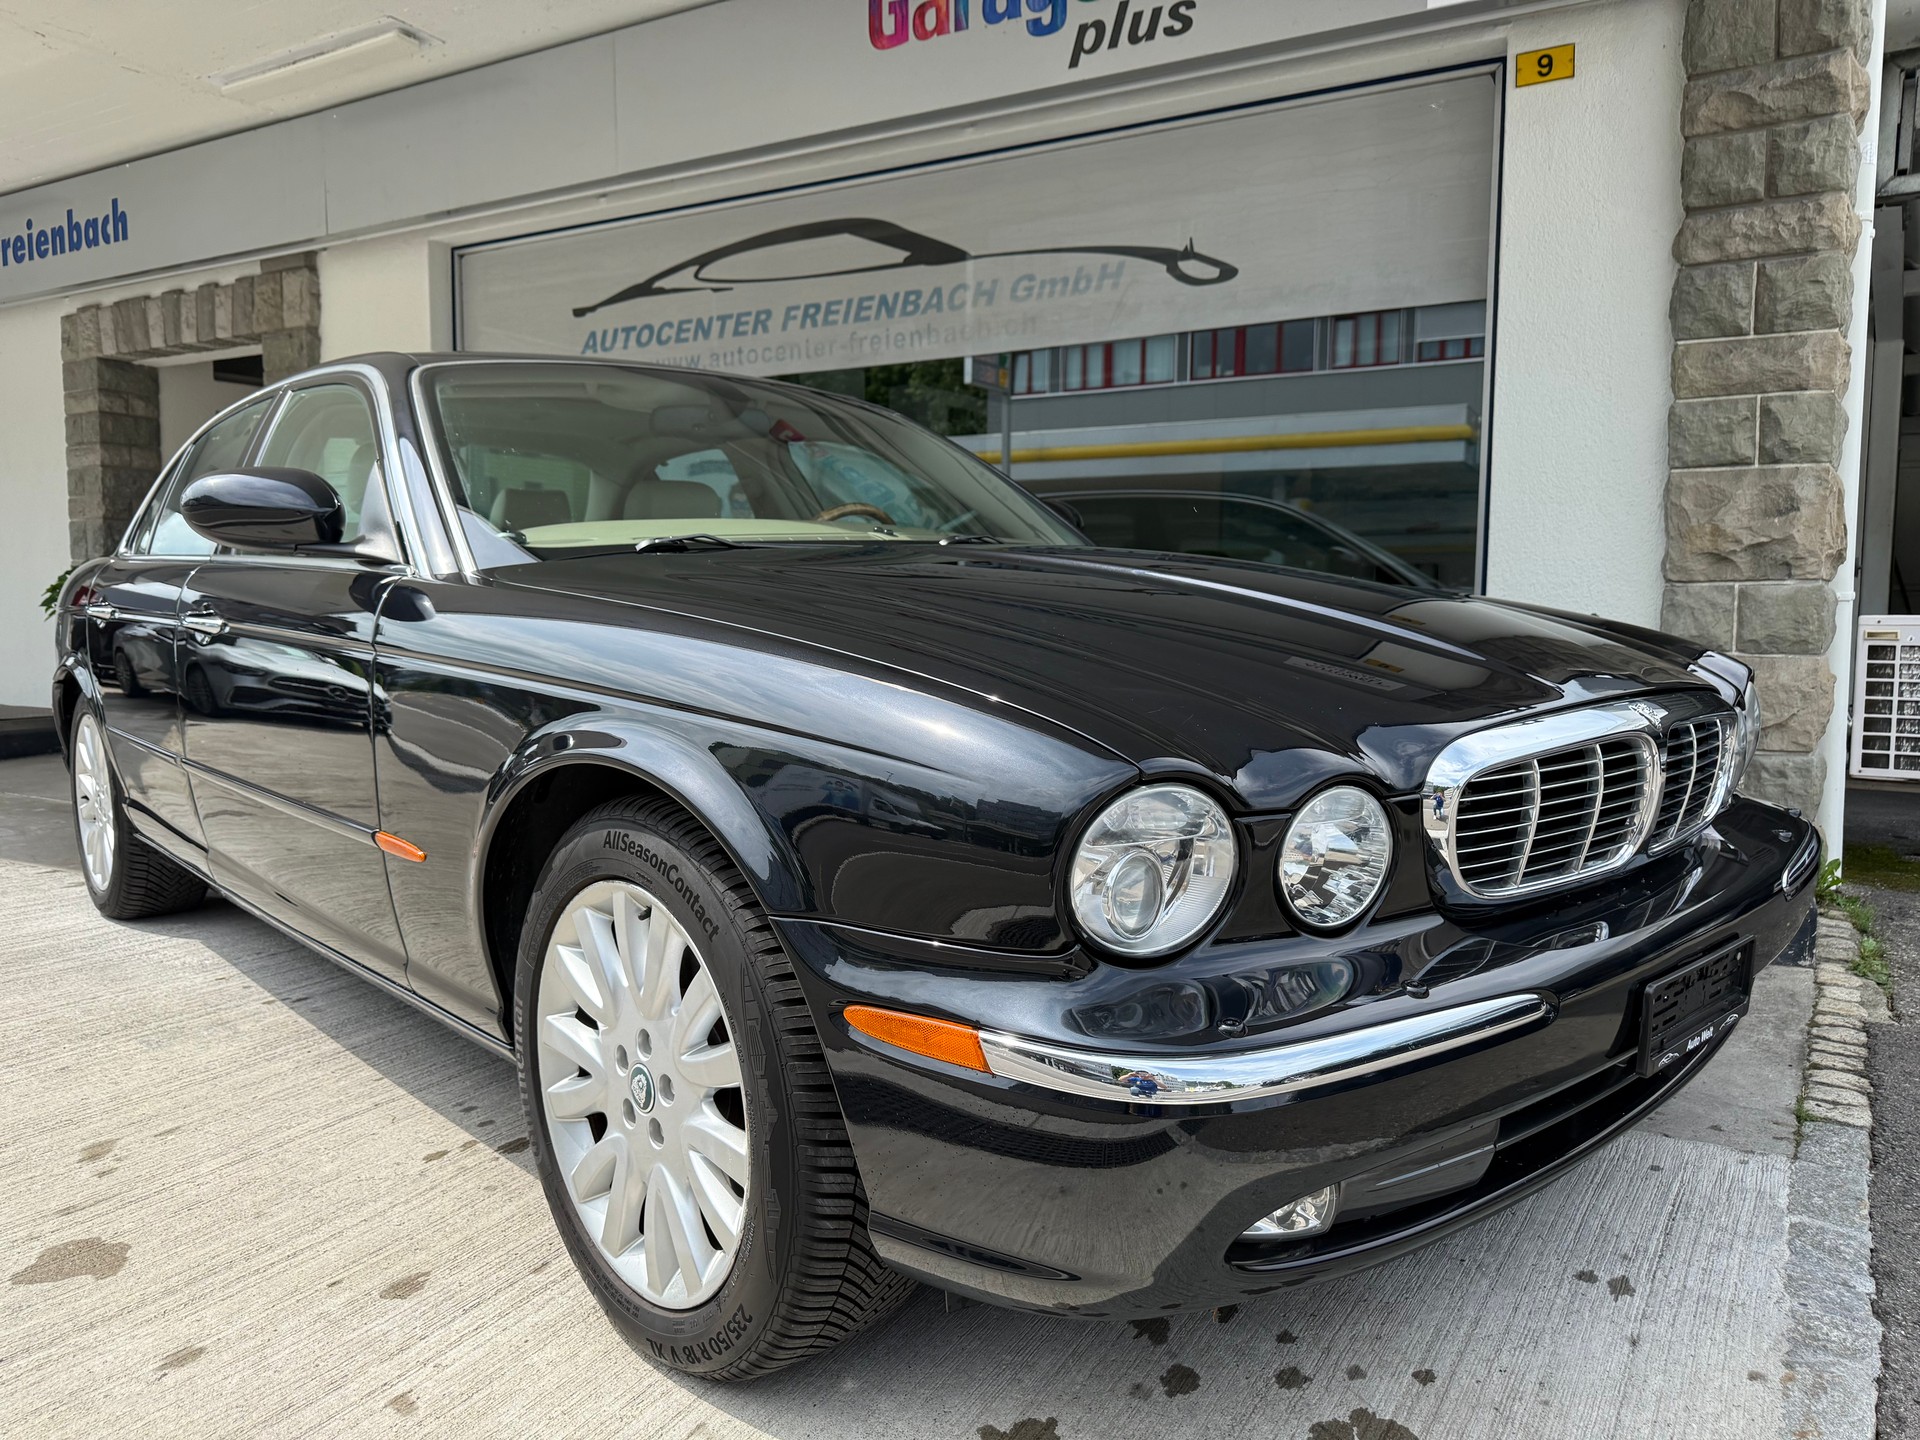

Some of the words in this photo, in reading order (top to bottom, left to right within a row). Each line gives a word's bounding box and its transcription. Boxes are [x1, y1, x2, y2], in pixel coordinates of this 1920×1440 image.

[1068, 0, 1196, 69] plus
[1537, 54, 1553, 77] 9
[1, 197, 128, 267] reienbach
[581, 308, 773, 355] AUTOCENTER
[781, 278, 999, 332] FREIENBACH
[1009, 260, 1126, 301] GmbH
[603, 830, 720, 942] AllSeasonContact
[645, 1337, 669, 1361] XL
[670, 1345, 684, 1365] V
[708, 1303, 753, 1356] 235/50
